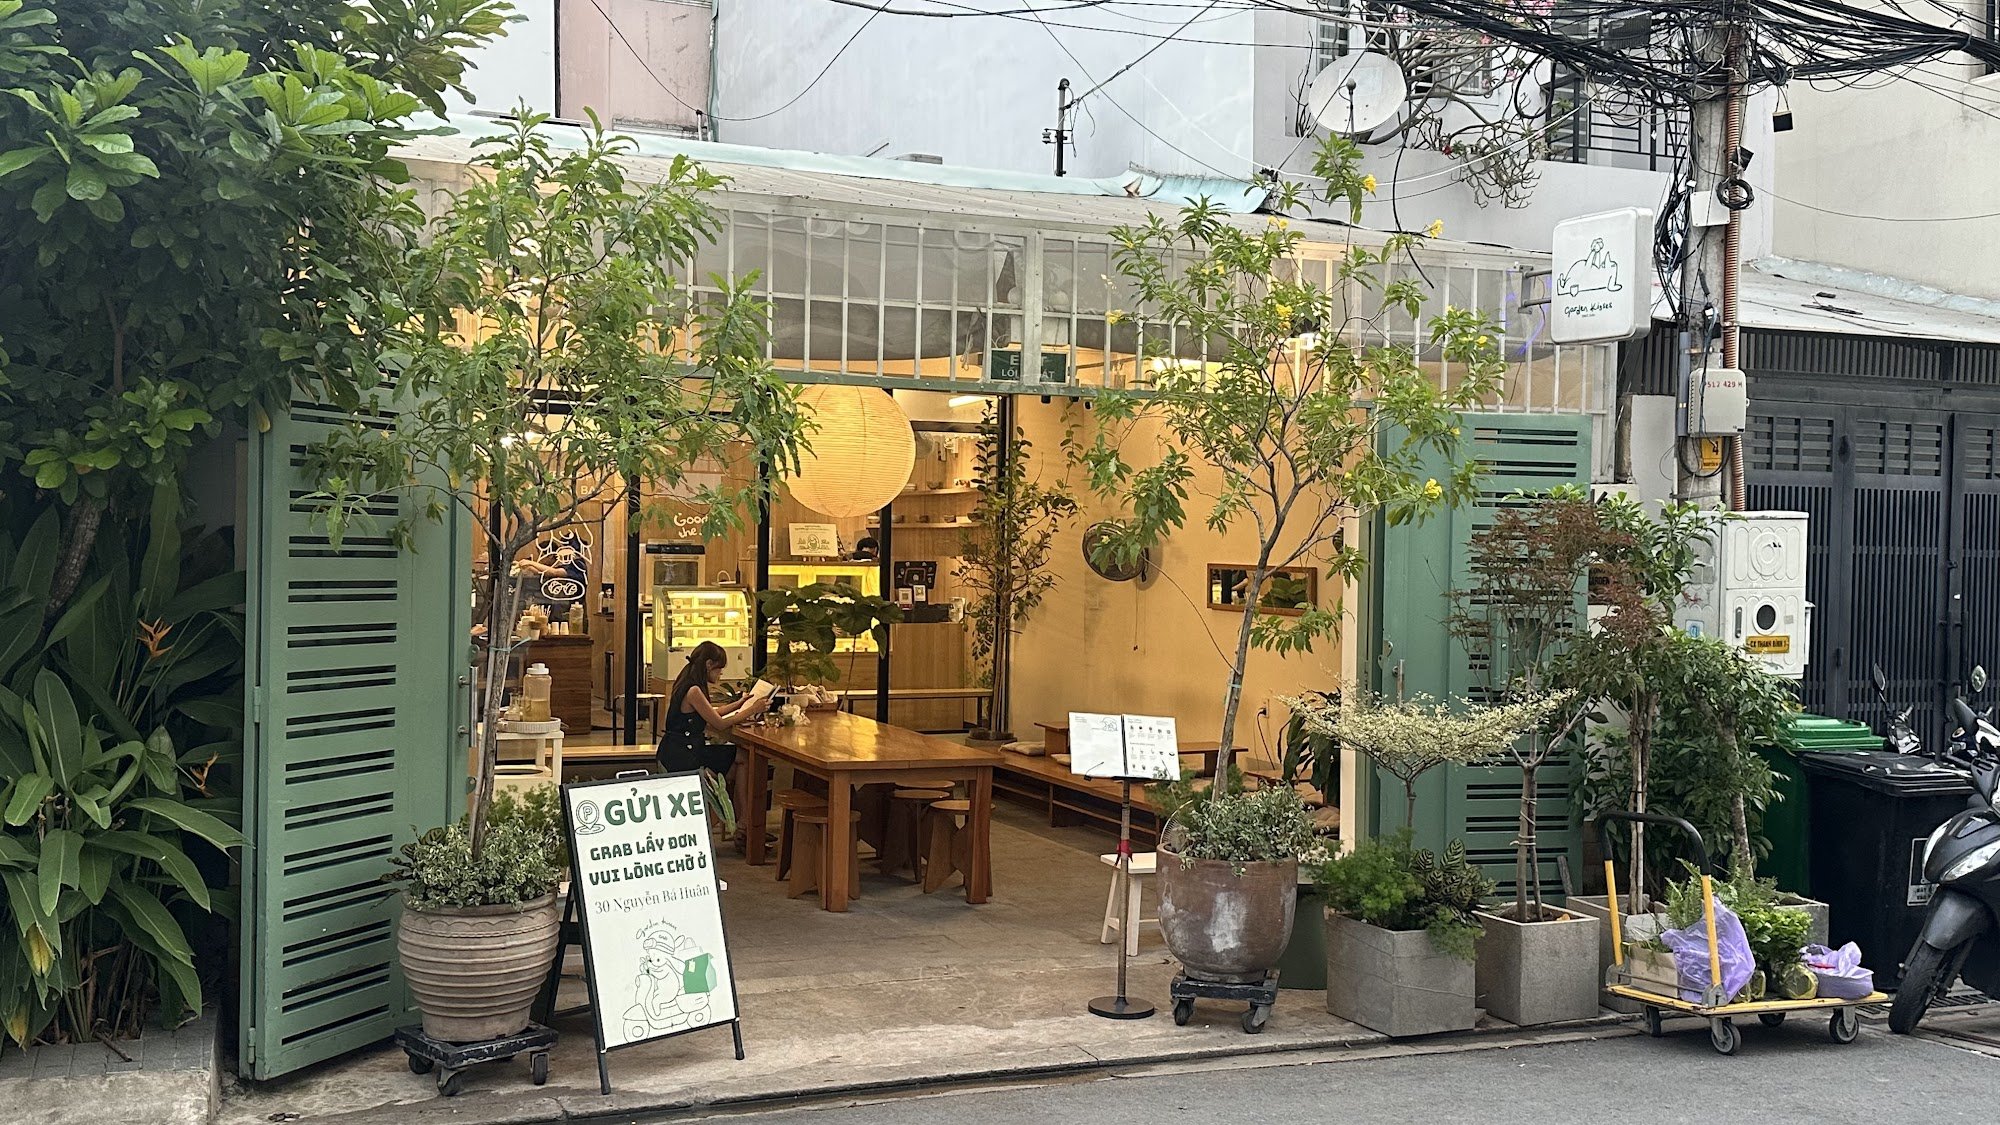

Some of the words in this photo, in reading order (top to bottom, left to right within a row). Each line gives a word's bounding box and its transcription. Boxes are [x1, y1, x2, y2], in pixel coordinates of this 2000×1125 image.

[1009, 354, 1048, 367] ET
[604, 787, 662, 826] GỬI
[667, 790, 704, 819] XE
[590, 843, 633, 861] GRAB
[636, 831, 665, 855] LẤY
[668, 833, 698, 850] ĐƠN
[589, 868, 621, 886] VUI
[623, 862, 665, 881] LÒNG
[666, 854, 695, 874] CHỜ
[697, 851, 707, 869] Ở
[594, 900, 610, 914] 30
[612, 890, 660, 914] Nguyễn
[662, 887, 678, 903] Bá
[679, 884, 710, 900] Huân
